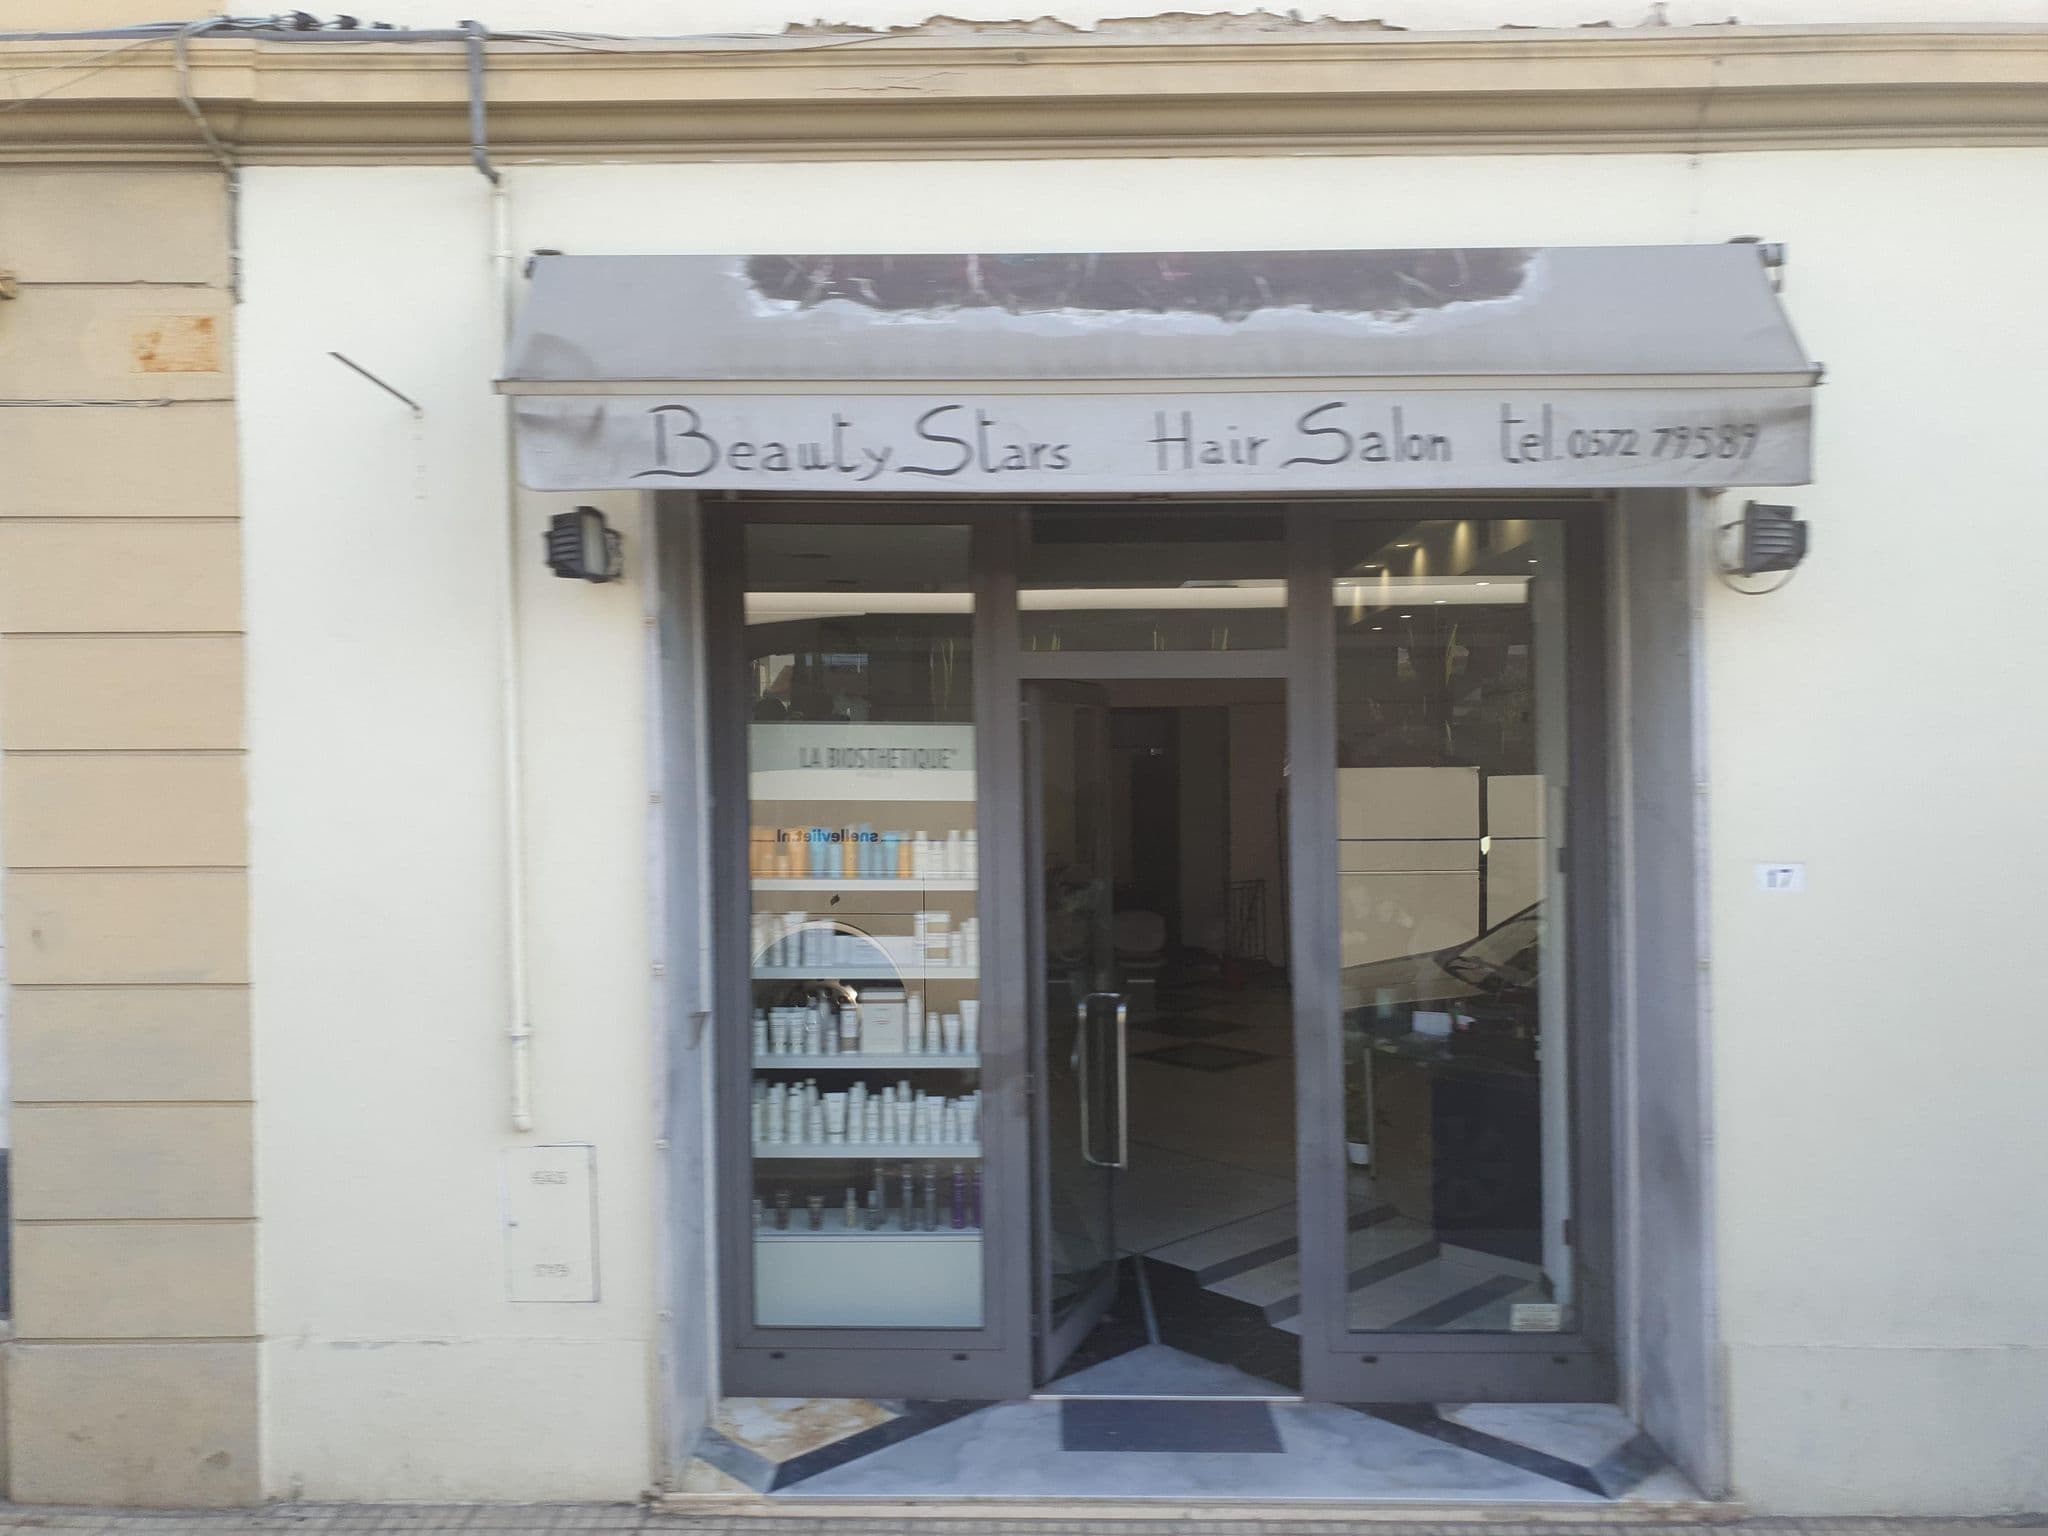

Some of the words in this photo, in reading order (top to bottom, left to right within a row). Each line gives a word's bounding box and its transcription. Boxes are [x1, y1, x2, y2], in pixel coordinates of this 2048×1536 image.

[629, 403, 893, 482] Beauty
[897, 403, 1073, 476] Stars
[1147, 410, 1270, 471] Hair
[1279, 401, 1453, 469] Salon
[1567, 427, 1640, 460] 0572
[1651, 422, 1761, 460] 79589
[799, 747, 822, 769] LA
